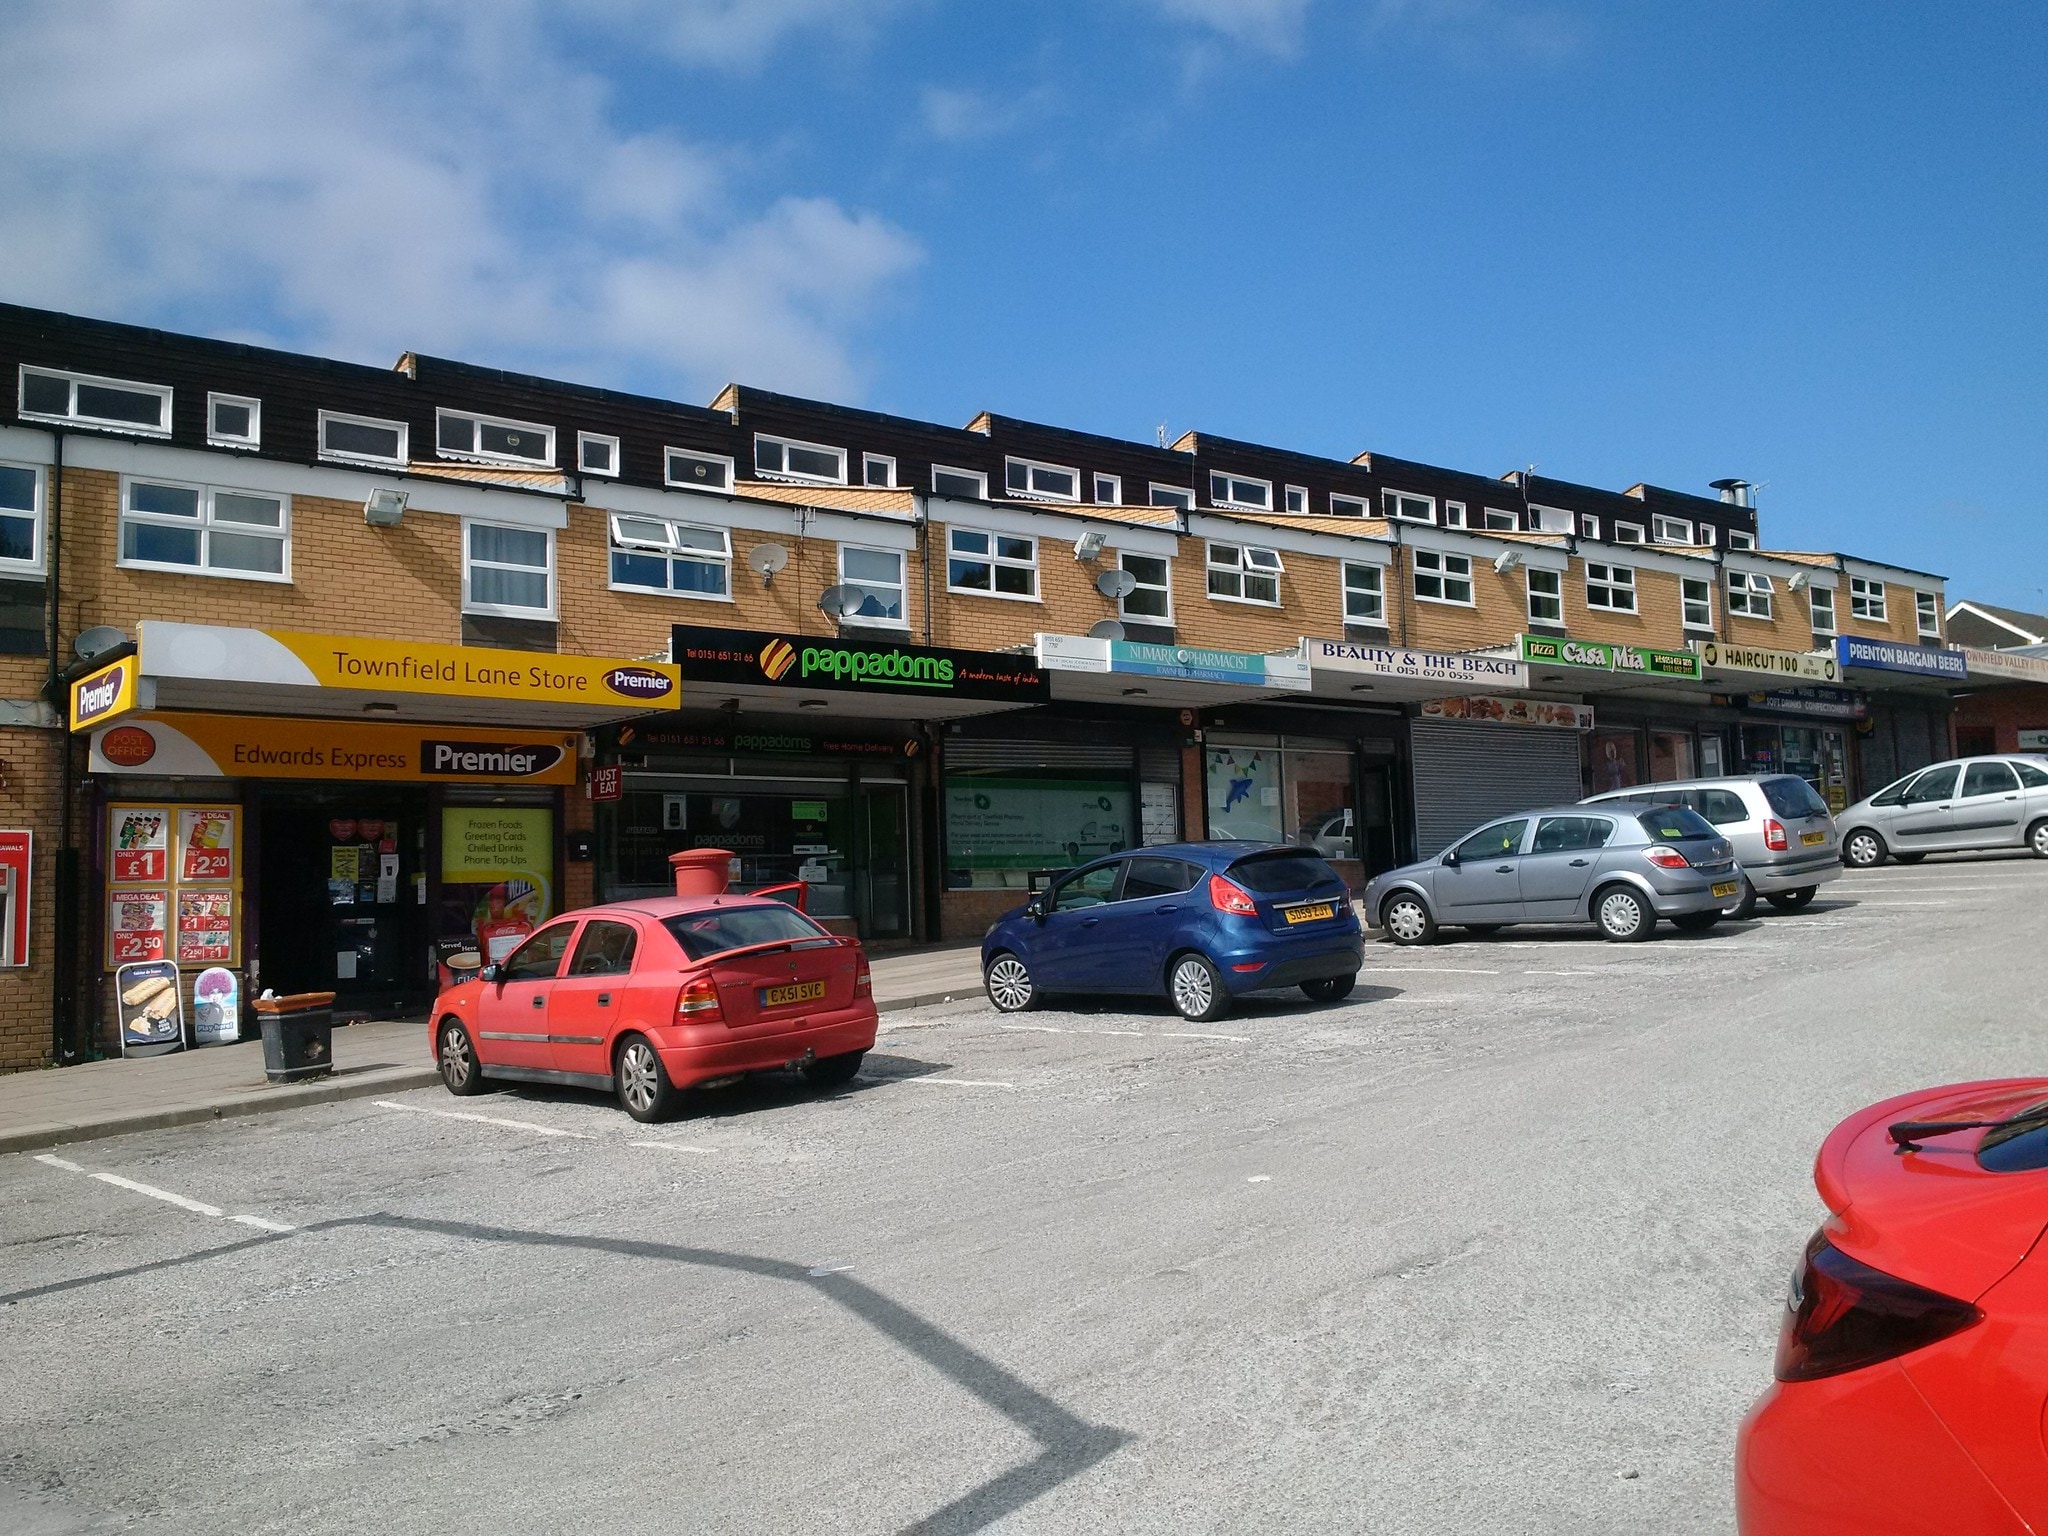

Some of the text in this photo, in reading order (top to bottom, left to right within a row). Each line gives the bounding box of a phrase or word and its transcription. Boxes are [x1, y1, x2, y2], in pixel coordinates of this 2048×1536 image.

[686, 648, 754, 663] Tel 0151 651 21 66
[1130, 645, 1249, 670] NUMARK PHARMACIST
[1322, 643, 1517, 676] BEAUTY & THE BEACH
[1530, 641, 1646, 673] pizza Casa Mia
[1725, 649, 1798, 673] HAIRCUT 100
[1849, 643, 1895, 663] PRENTON
[1896, 651, 1938, 669] BARGAIN
[1938, 656, 1963, 673] BEERS
[2004, 656, 2030, 670] VALLEY
[332, 651, 588, 691] Townfield Lane Store
[801, 647, 955, 682] pappadoms
[1374, 663, 1475, 681] TEL 0151 670 0555
[614, 671, 671, 690] Premier
[958, 668, 967, 679] A
[1013, 672, 1022, 685] of
[1192, 669, 1226, 680] PHARMACY
[80, 680, 115, 716] Premier
[113, 735, 144, 745] POST
[646, 733, 726, 745] Tel 0151 651 21 66
[734, 734, 812, 750] pappadoms
[107, 746, 149, 757] OFFICE
[823, 741, 894, 753] Free Home Delivery
[234, 744, 407, 772] Edwards Express
[435, 744, 537, 772] Premier
[594, 768, 618, 783] JUST
[599, 781, 618, 795] EAT
[468, 820, 523, 829] Frozen Foods
[464, 831, 527, 842] Greeting Cards
[694, 832, 766, 847] pappadoms
[467, 843, 524, 853] Chilled Drinks
[128, 851, 153, 875] £1
[464, 855, 528, 866] Phone Top-Ups
[1314, 906, 1330, 918] ZJY
[440, 942, 462, 950] Served
[770, 983, 822, 1003] EX51 SVE
[197, 1024, 213, 1033] Play
